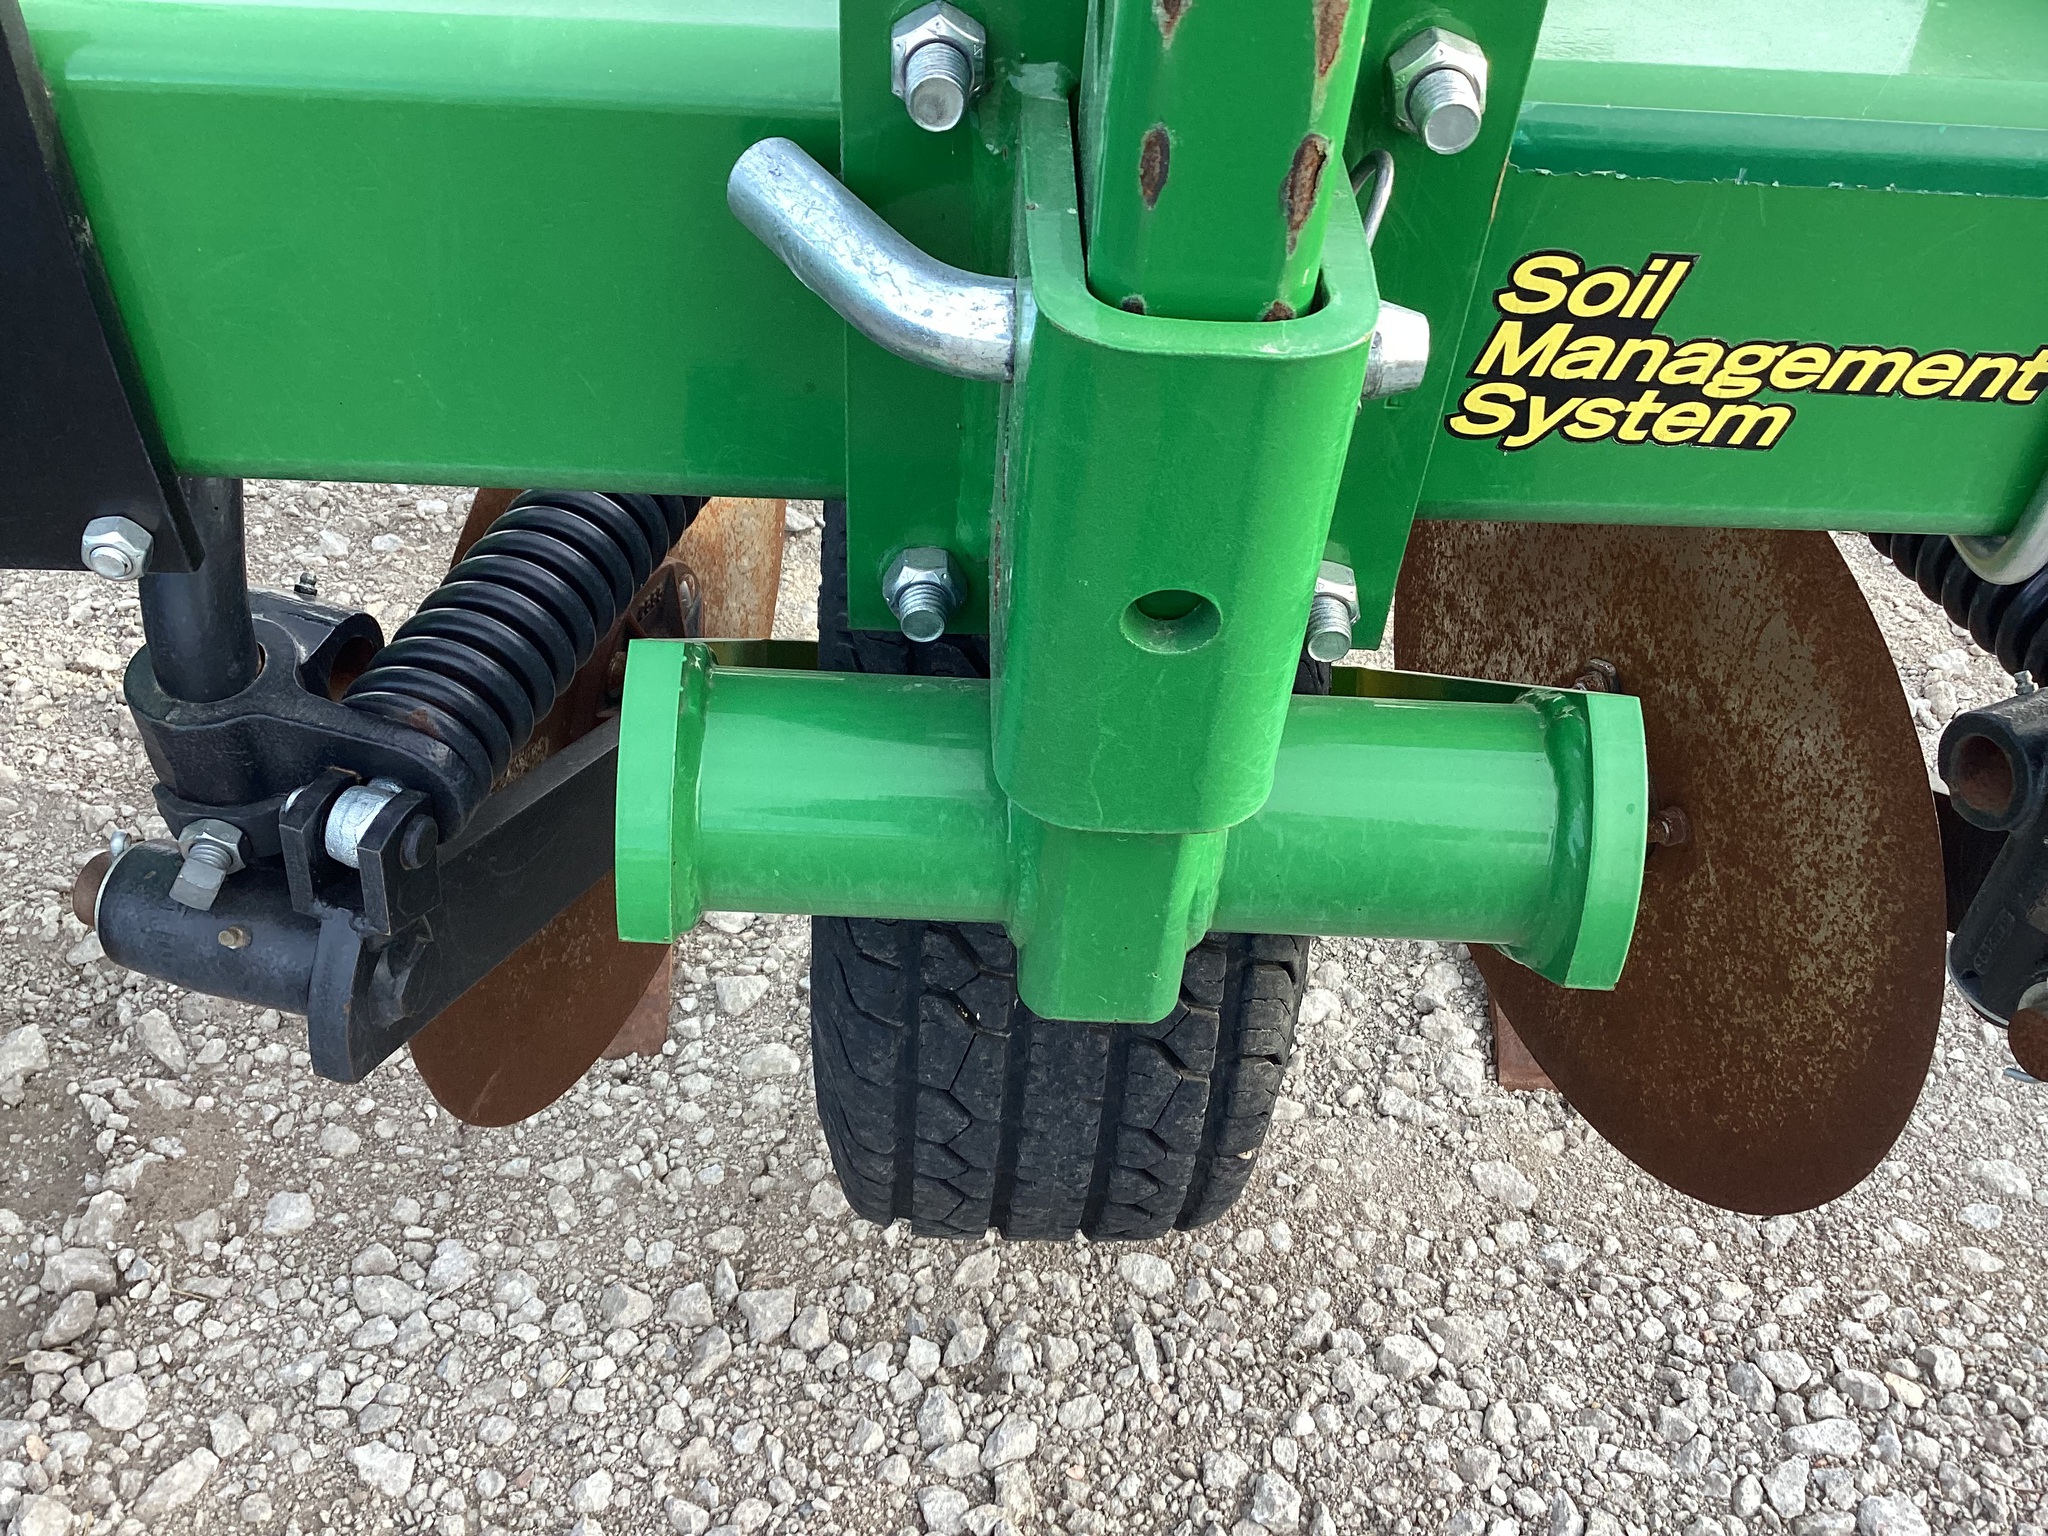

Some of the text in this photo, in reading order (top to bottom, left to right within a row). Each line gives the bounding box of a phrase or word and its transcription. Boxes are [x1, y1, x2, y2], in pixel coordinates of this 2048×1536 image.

[1498, 255, 1692, 319] Soil
[1474, 320, 2048, 401] Management
[1449, 382, 1791, 447] System
